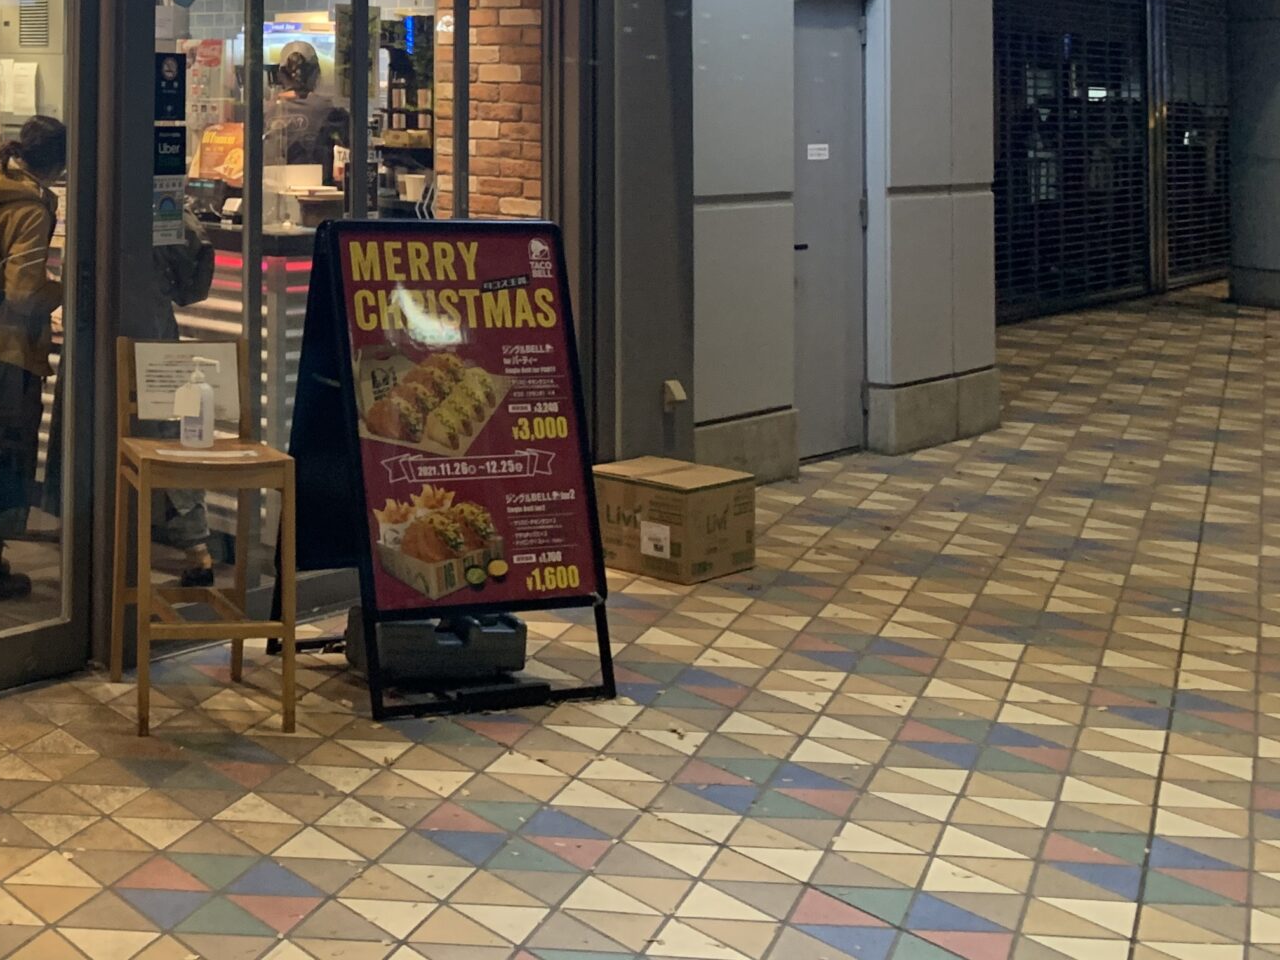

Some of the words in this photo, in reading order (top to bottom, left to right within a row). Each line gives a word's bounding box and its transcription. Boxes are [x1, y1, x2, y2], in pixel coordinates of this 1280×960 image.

[159, 142, 180, 154] Uber
[349, 241, 478, 281] MERRY
[529, 261, 552, 269] TACO
[532, 269, 553, 278] BELL
[512, 416, 568, 441] ¥3,000
[526, 564, 580, 591] ¥1,600
